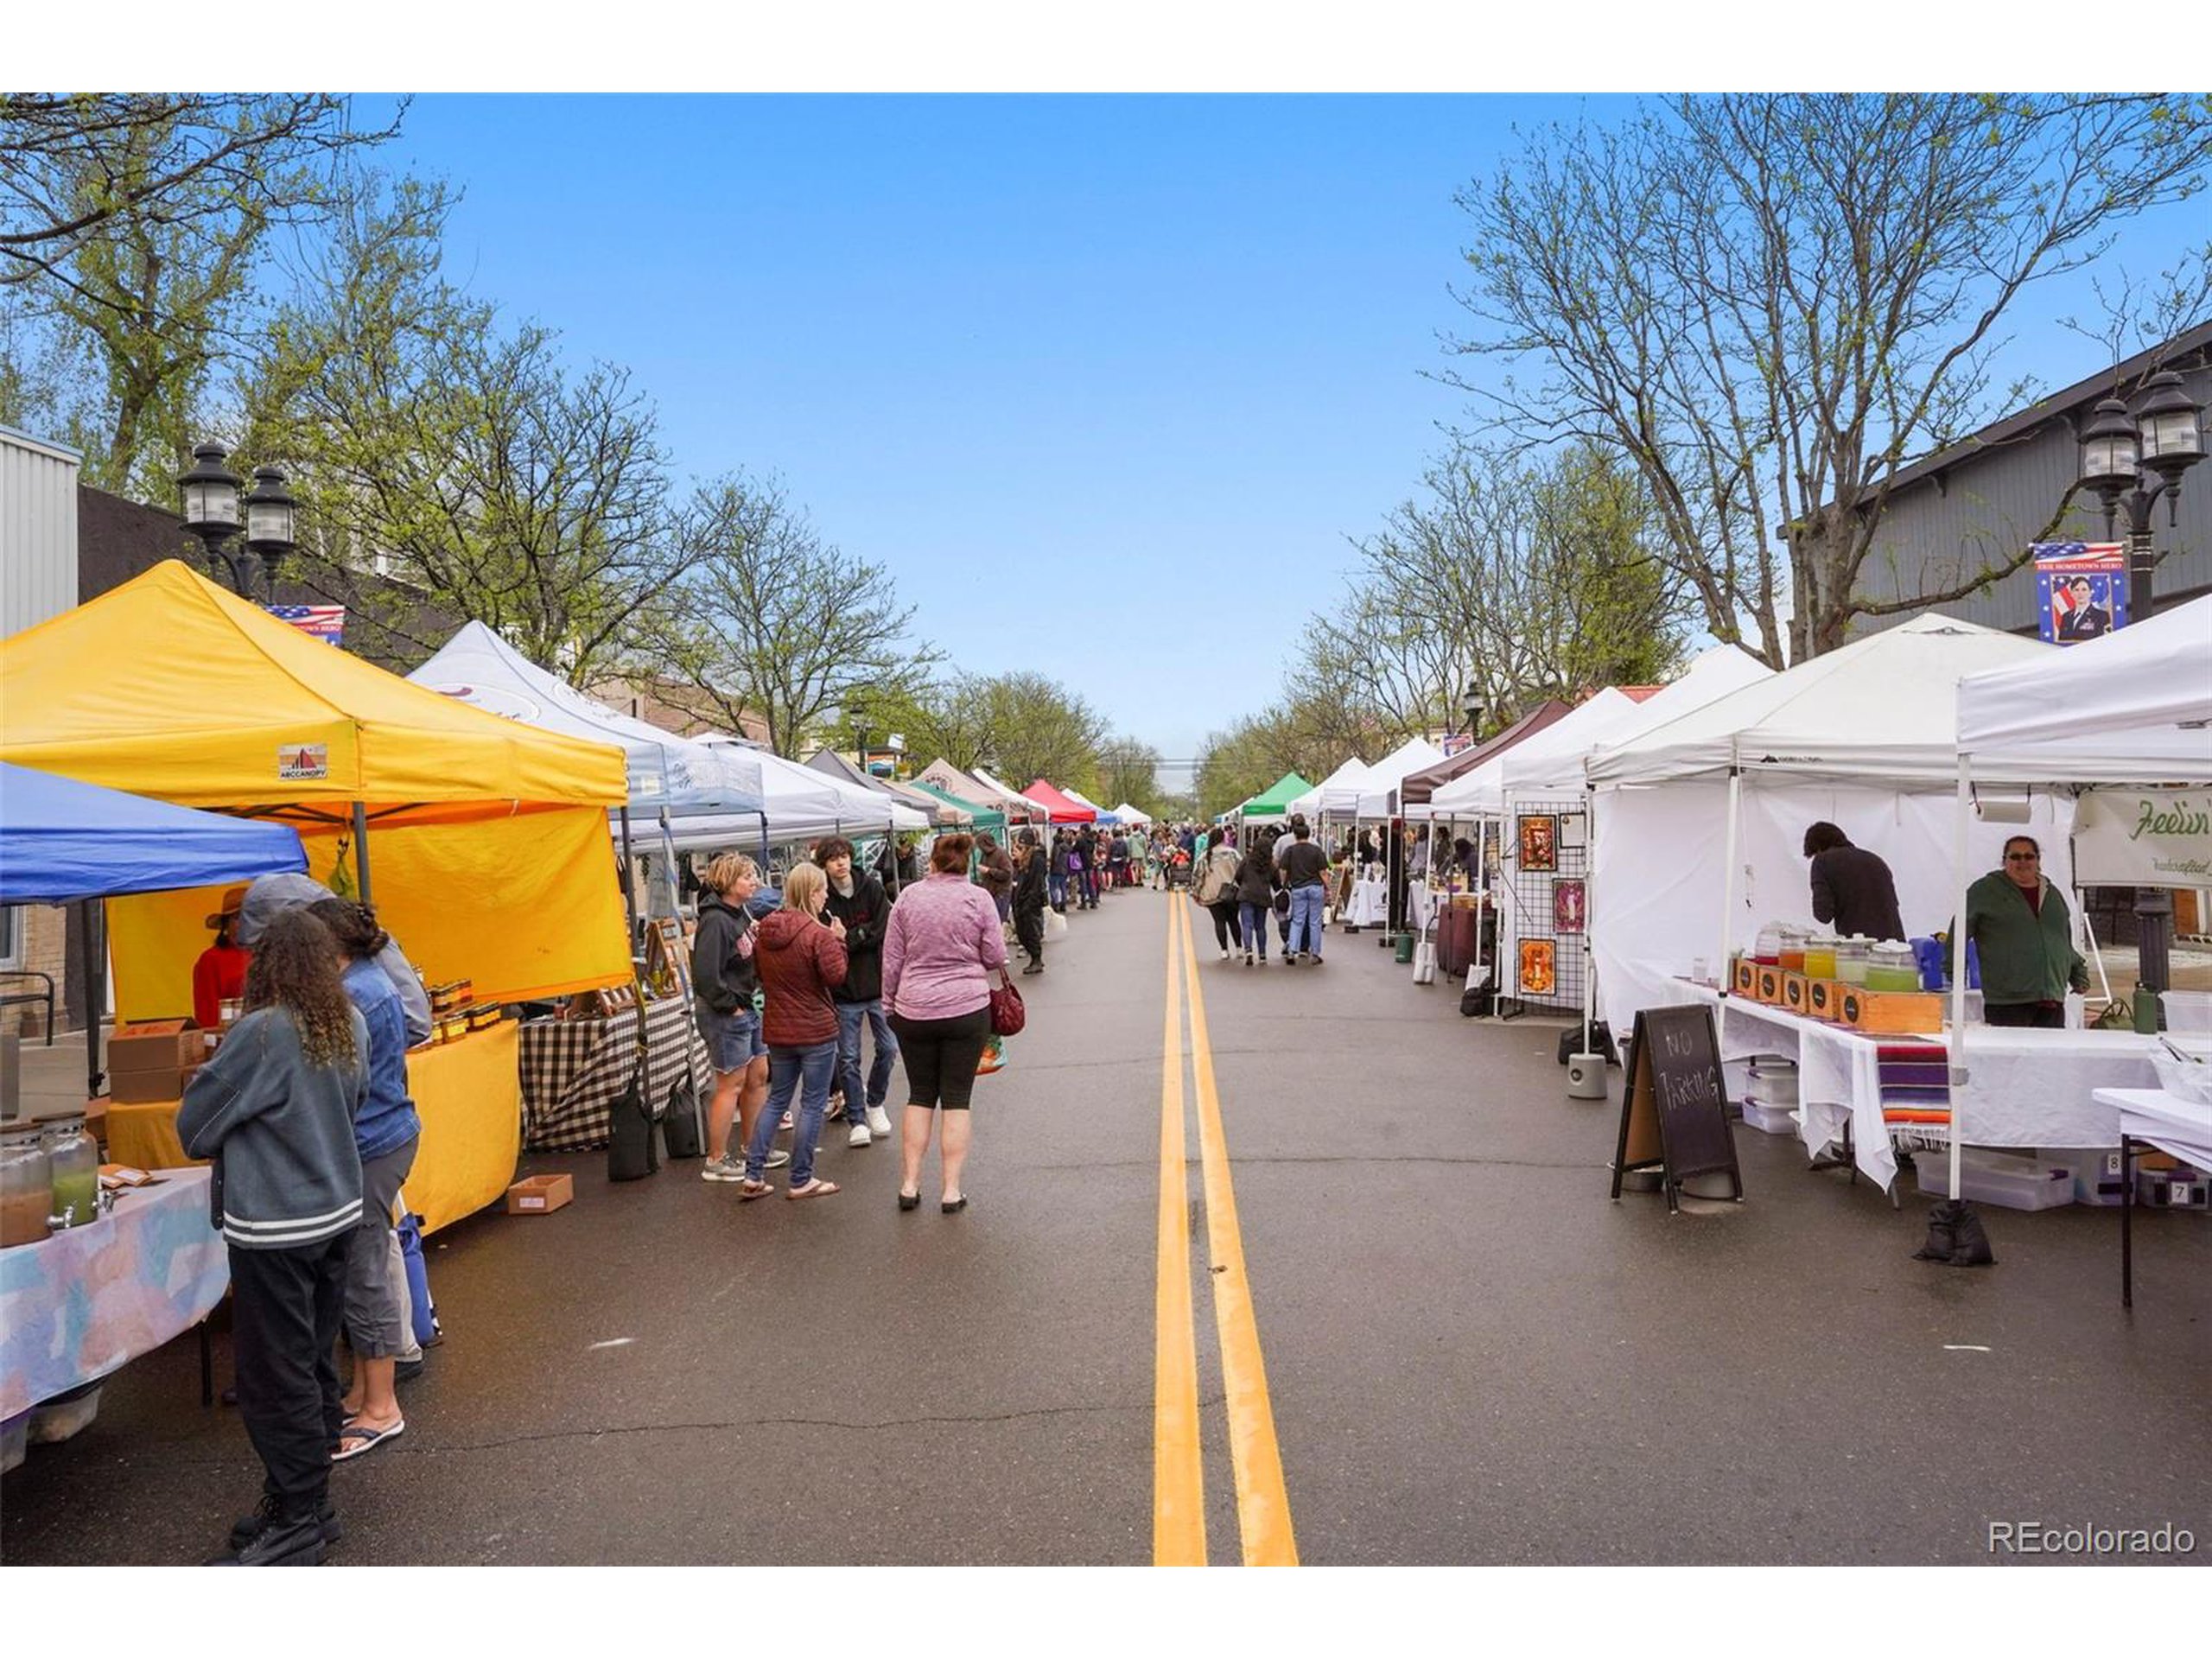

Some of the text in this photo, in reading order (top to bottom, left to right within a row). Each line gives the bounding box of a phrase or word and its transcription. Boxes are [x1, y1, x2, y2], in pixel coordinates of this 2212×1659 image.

[1665, 1031, 1693, 1057] NO
[1659, 1065, 1721, 1111] PARKING
[2110, 1156, 2119, 1169] 8
[2175, 1185, 2184, 1198] 7
